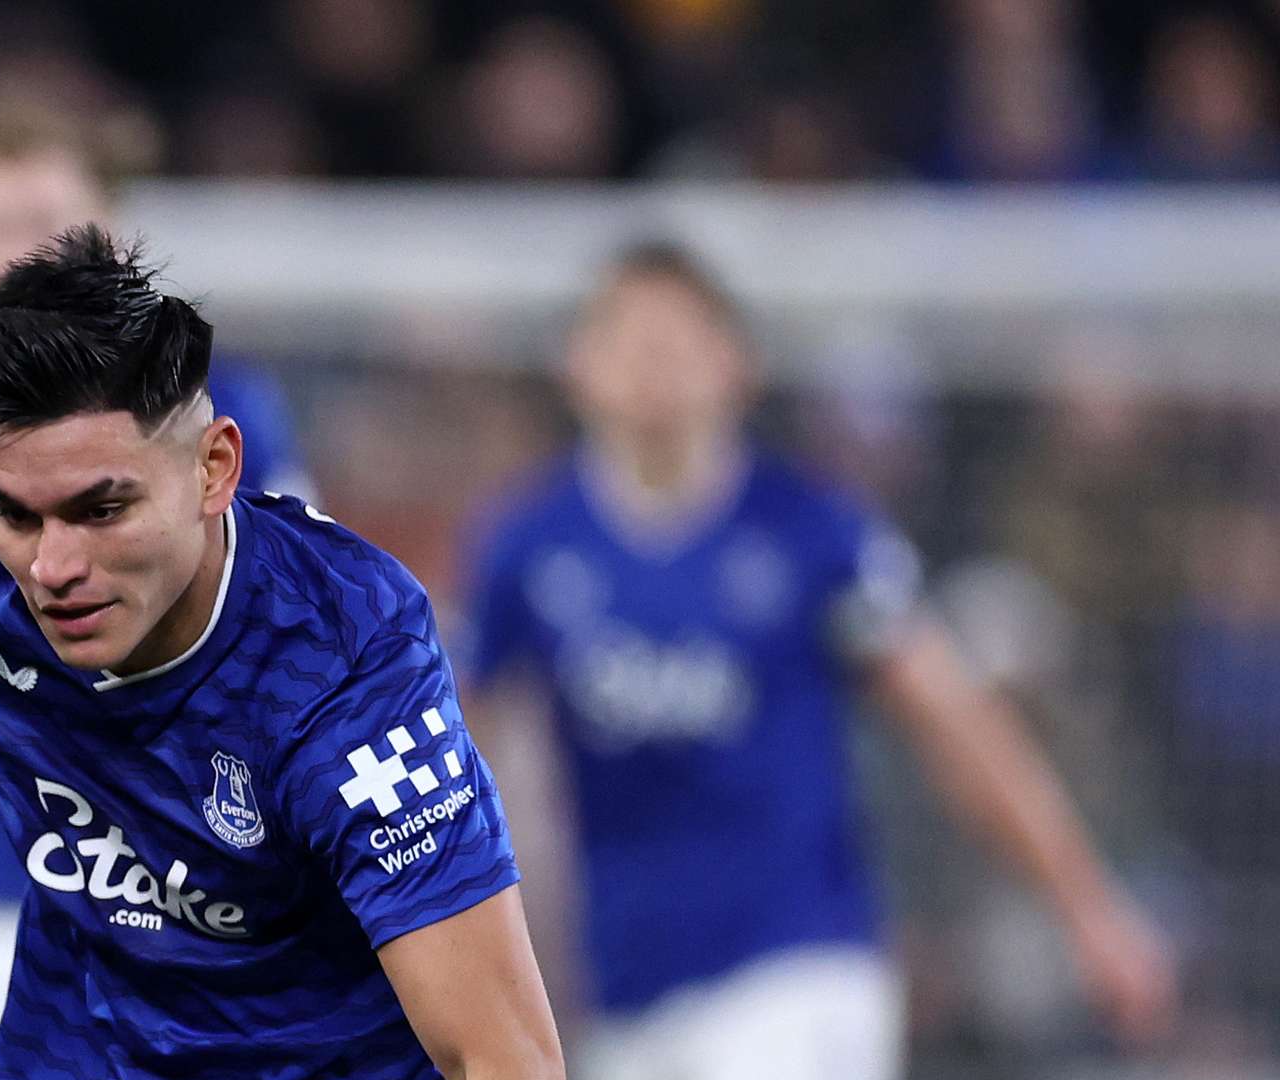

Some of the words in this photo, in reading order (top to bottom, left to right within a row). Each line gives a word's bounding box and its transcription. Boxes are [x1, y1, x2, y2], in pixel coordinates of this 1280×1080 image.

[221, 800, 256, 822] Everton
[370, 784, 475, 850] Christopher
[27, 777, 253, 937] Stake
[378, 831, 438, 875] Ward
[109, 909, 163, 931] .com
